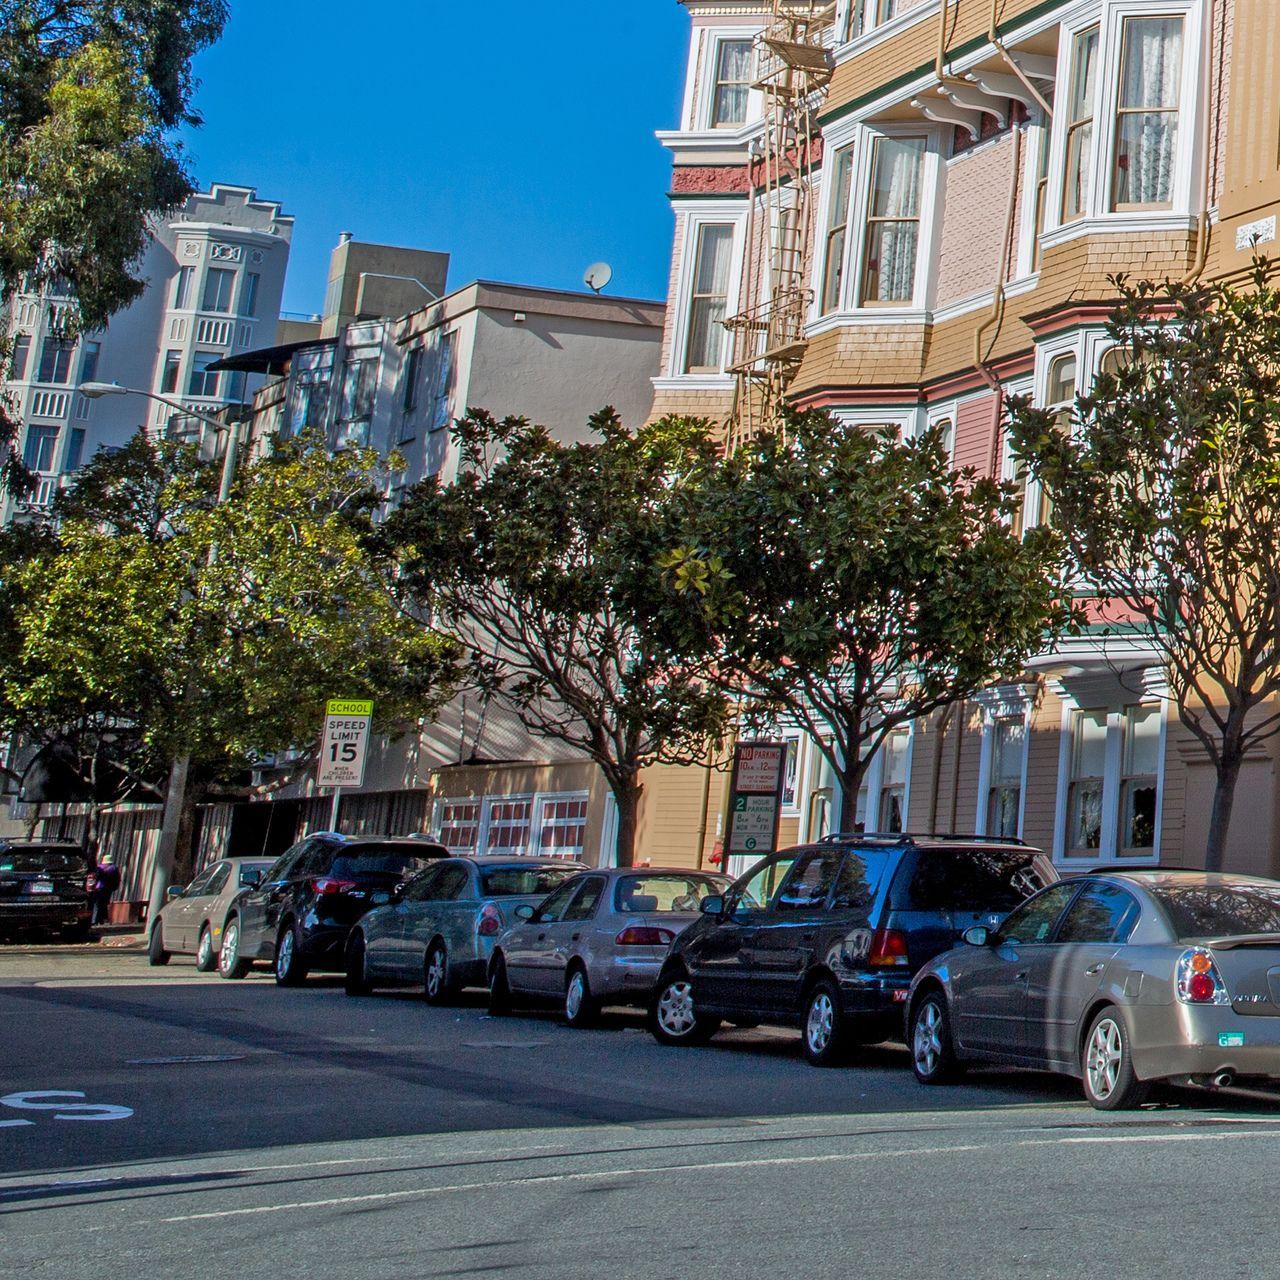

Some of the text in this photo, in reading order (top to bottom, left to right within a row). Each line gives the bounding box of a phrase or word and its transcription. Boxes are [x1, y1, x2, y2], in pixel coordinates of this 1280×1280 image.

[330, 703, 369, 713] SCHOOL
[329, 721, 366, 730] SPEED
[331, 732, 361, 740] LIMIT
[330, 742, 358, 762] 15
[740, 746, 780, 760] NO PARKING
[736, 798, 745, 810] 2
